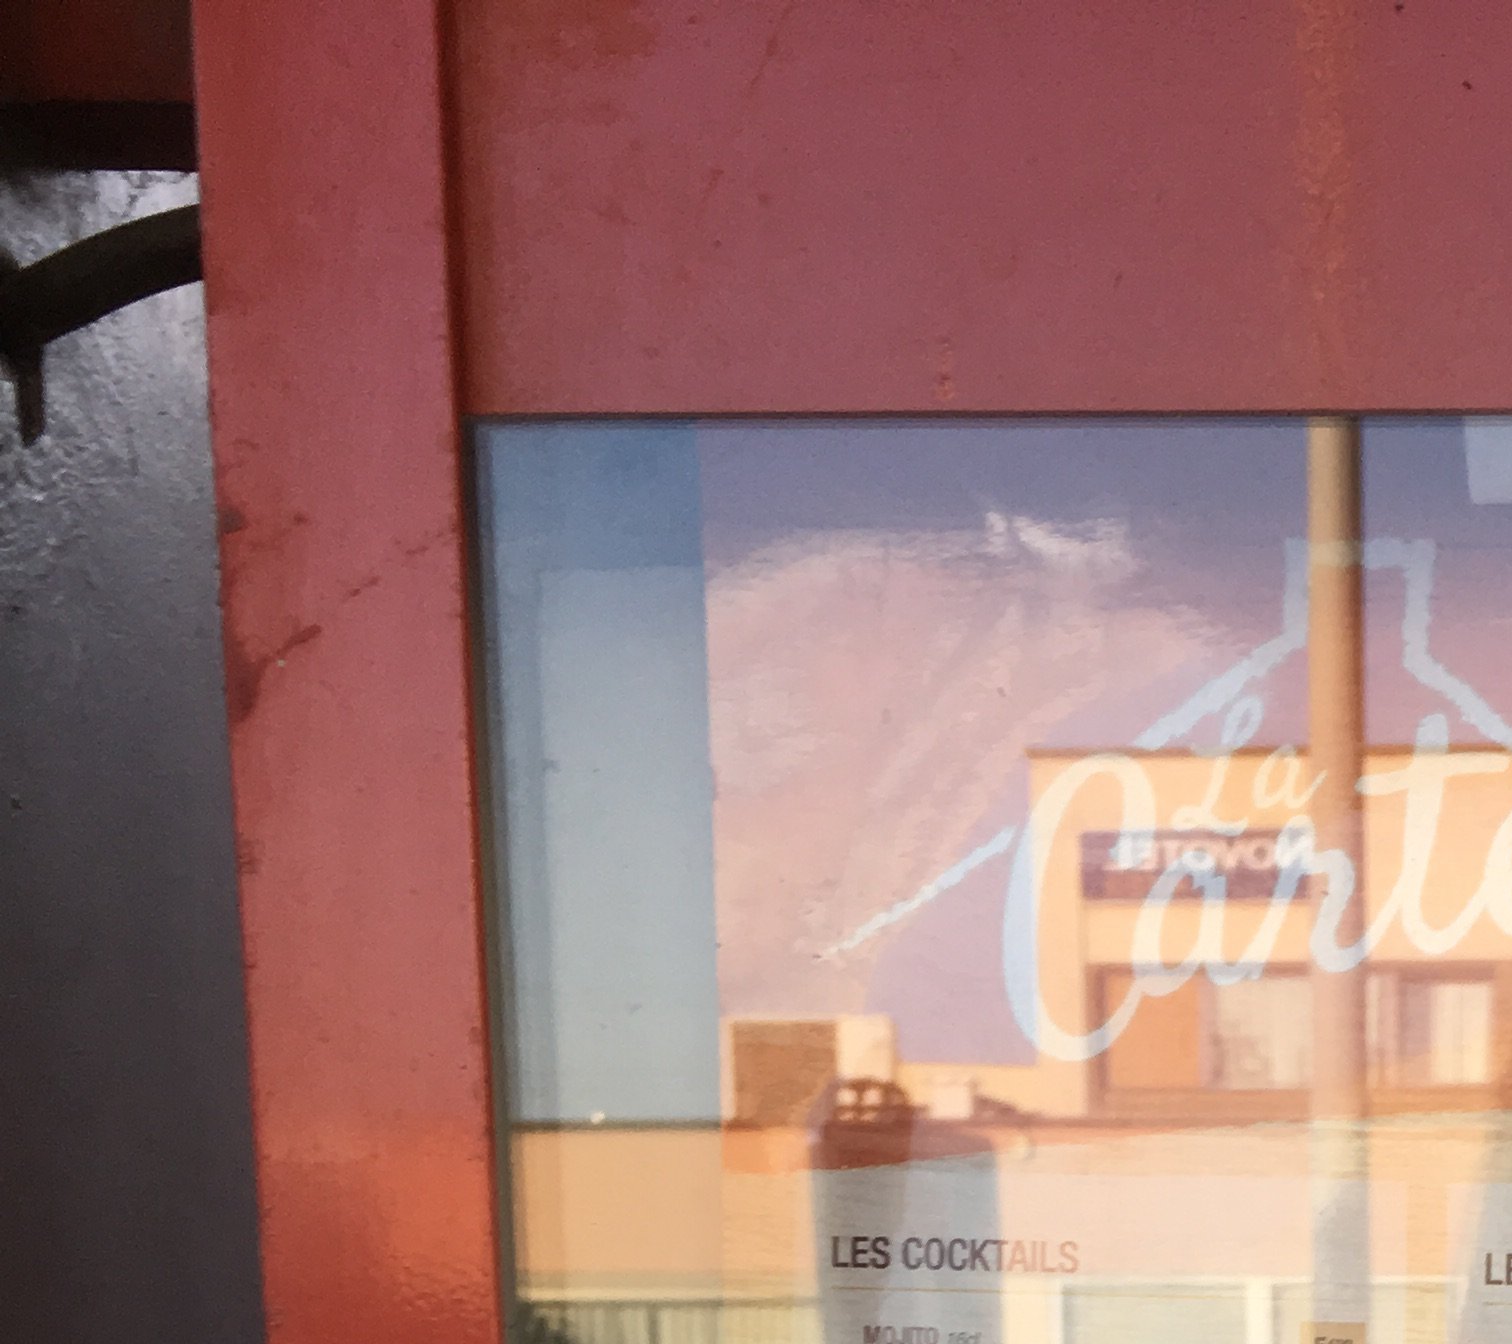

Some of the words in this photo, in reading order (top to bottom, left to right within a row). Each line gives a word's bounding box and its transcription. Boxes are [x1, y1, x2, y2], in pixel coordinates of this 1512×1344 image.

[1172, 691, 1326, 832] La
[831, 1236, 890, 1269] LES
[902, 1238, 1080, 1273] COCKTAILS
